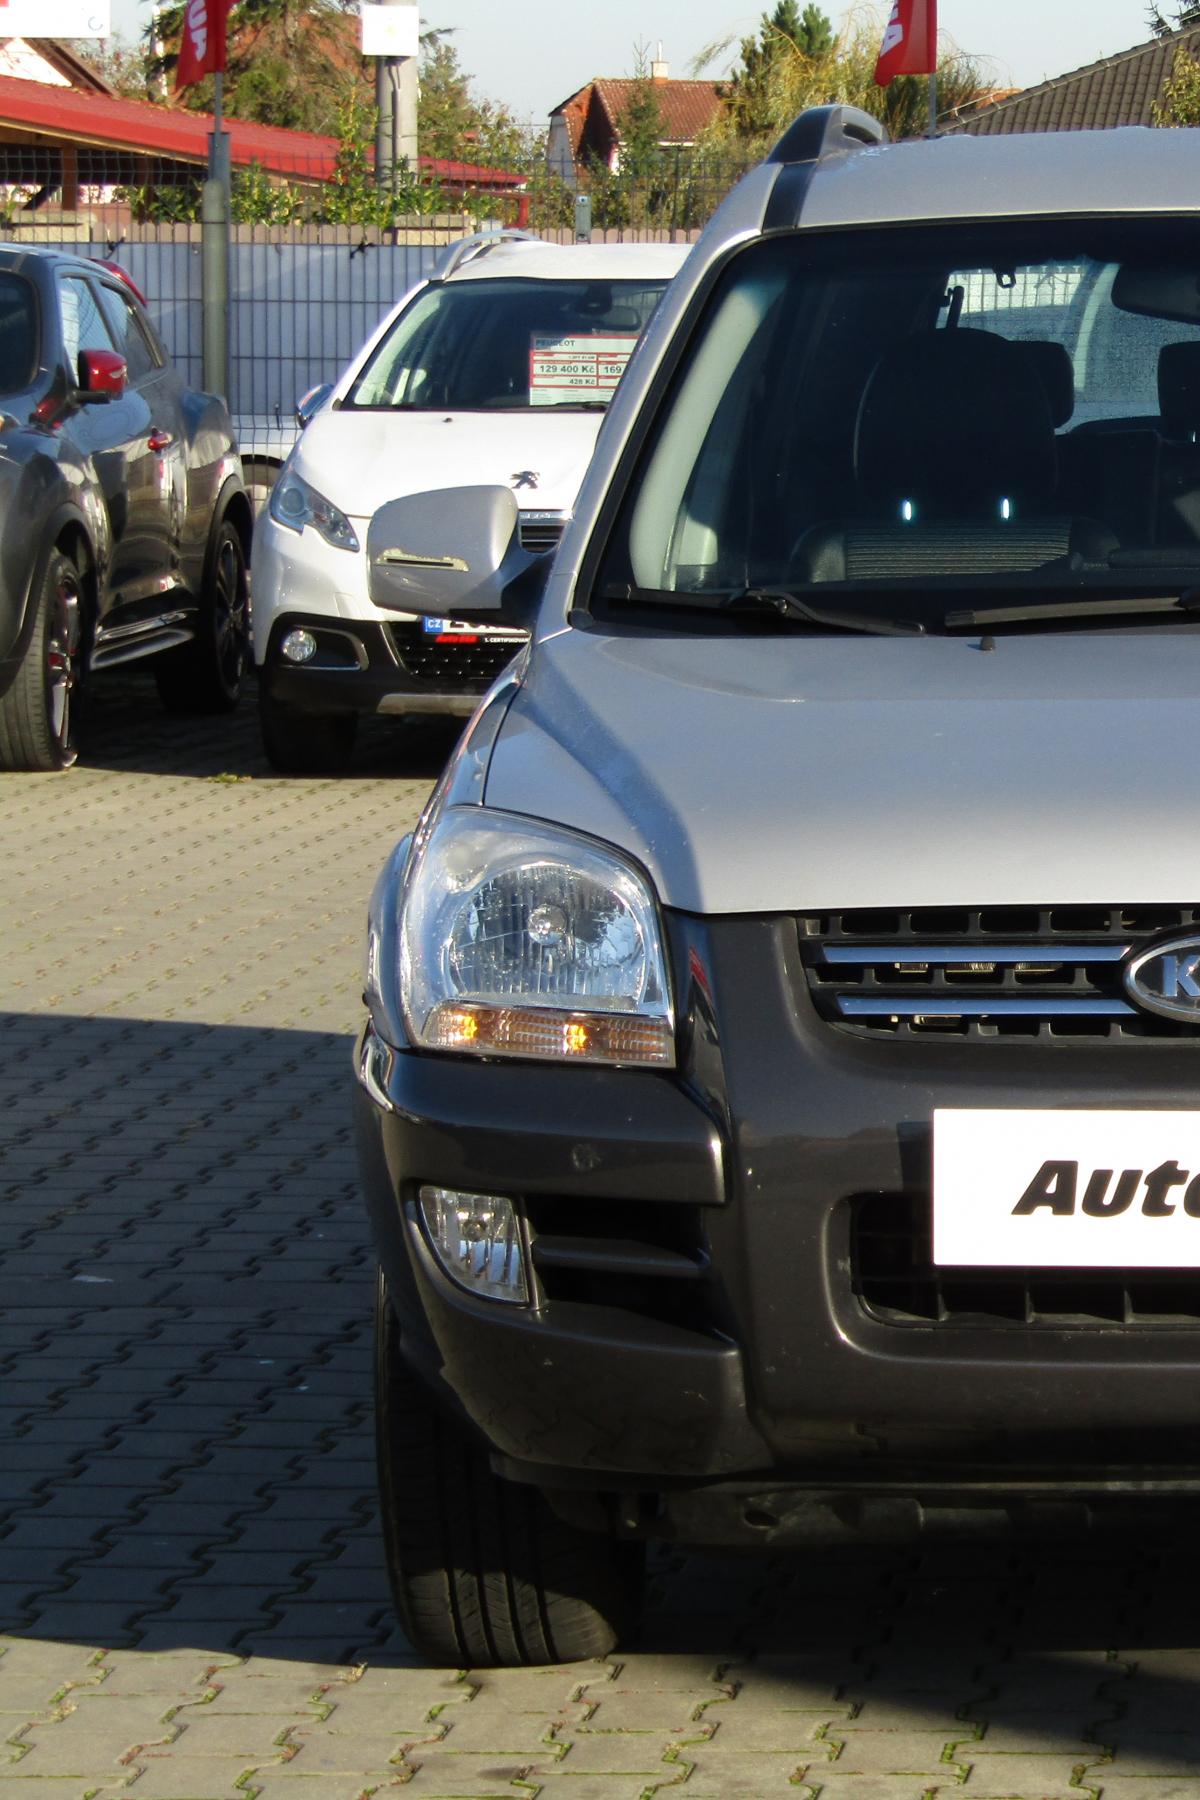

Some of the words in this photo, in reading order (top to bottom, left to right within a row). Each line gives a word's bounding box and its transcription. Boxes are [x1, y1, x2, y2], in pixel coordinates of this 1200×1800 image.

[540, 365, 557, 373] 129
[560, 365, 579, 373] 400
[581, 364, 595, 374] Kč
[604, 366, 622, 374] 169
[585, 378, 595, 386] Kč
[427, 620, 441, 628] CZ
